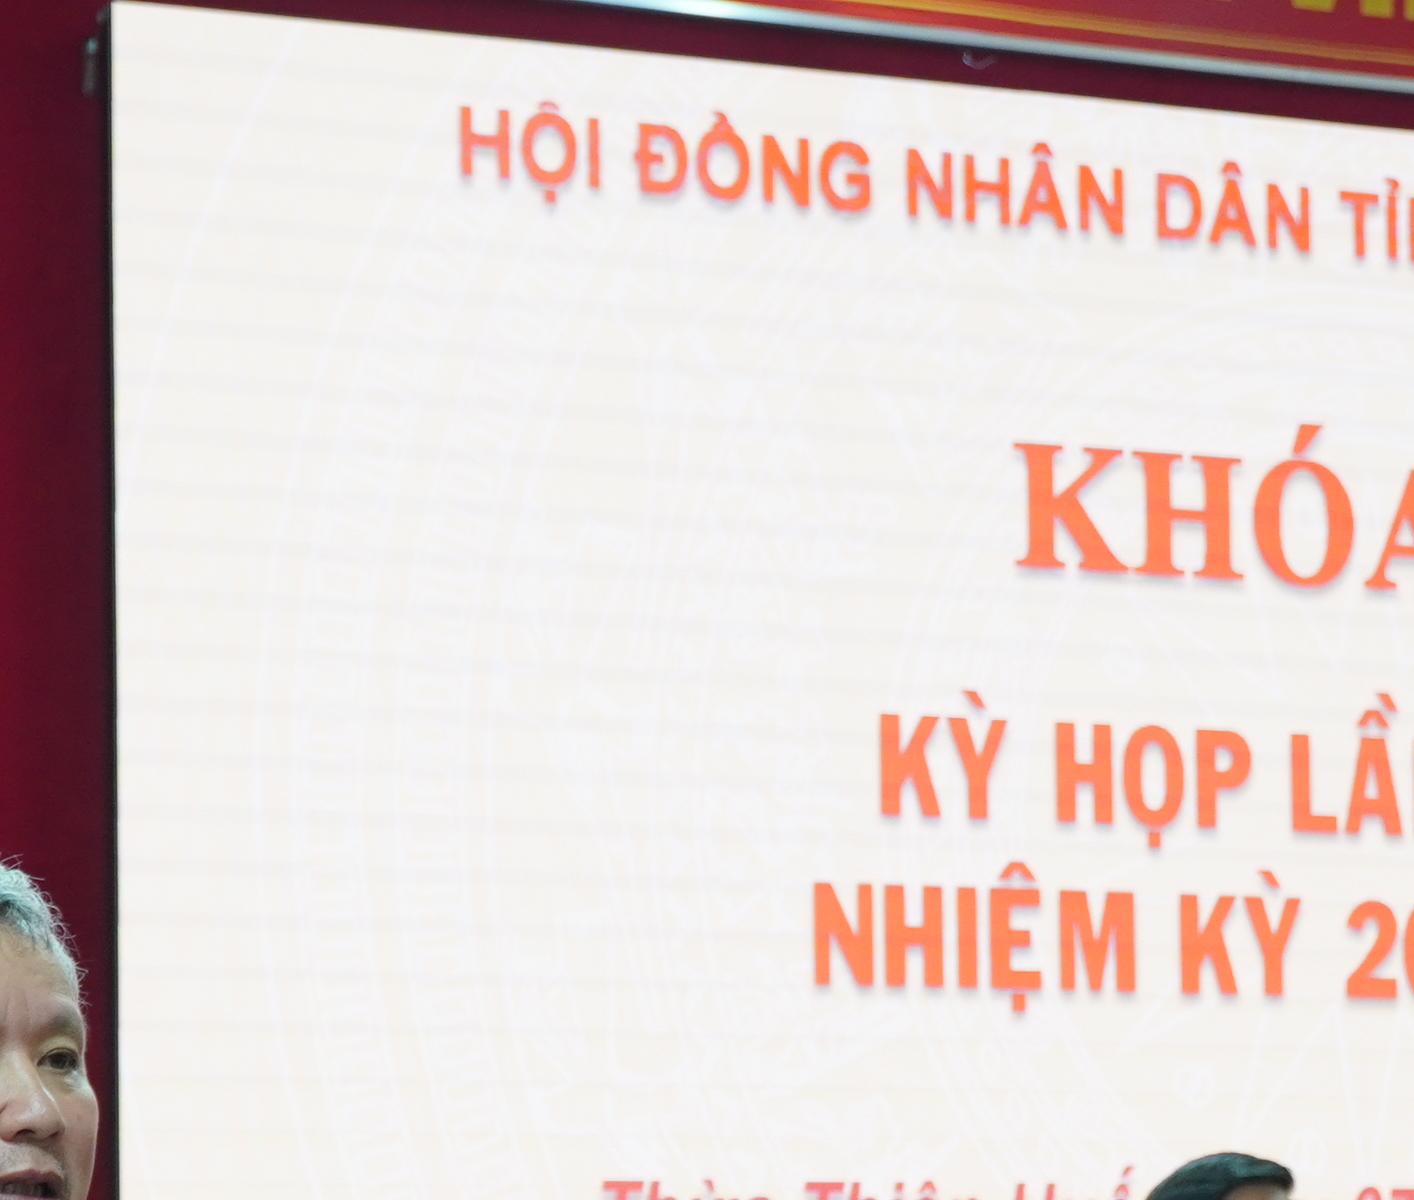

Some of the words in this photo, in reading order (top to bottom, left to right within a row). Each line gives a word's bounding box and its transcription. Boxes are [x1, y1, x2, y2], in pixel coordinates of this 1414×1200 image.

[460, 100, 600, 203] HỘI
[634, 111, 872, 213] ĐỒNG
[906, 143, 1125, 235] NHÂN
[1156, 161, 1311, 252] DÂN
[878, 690, 1008, 820] KỲ
[1055, 721, 1253, 849] HỌP
[813, 861, 1137, 1013] NHIỆM
[1179, 870, 1302, 997] KỲ
